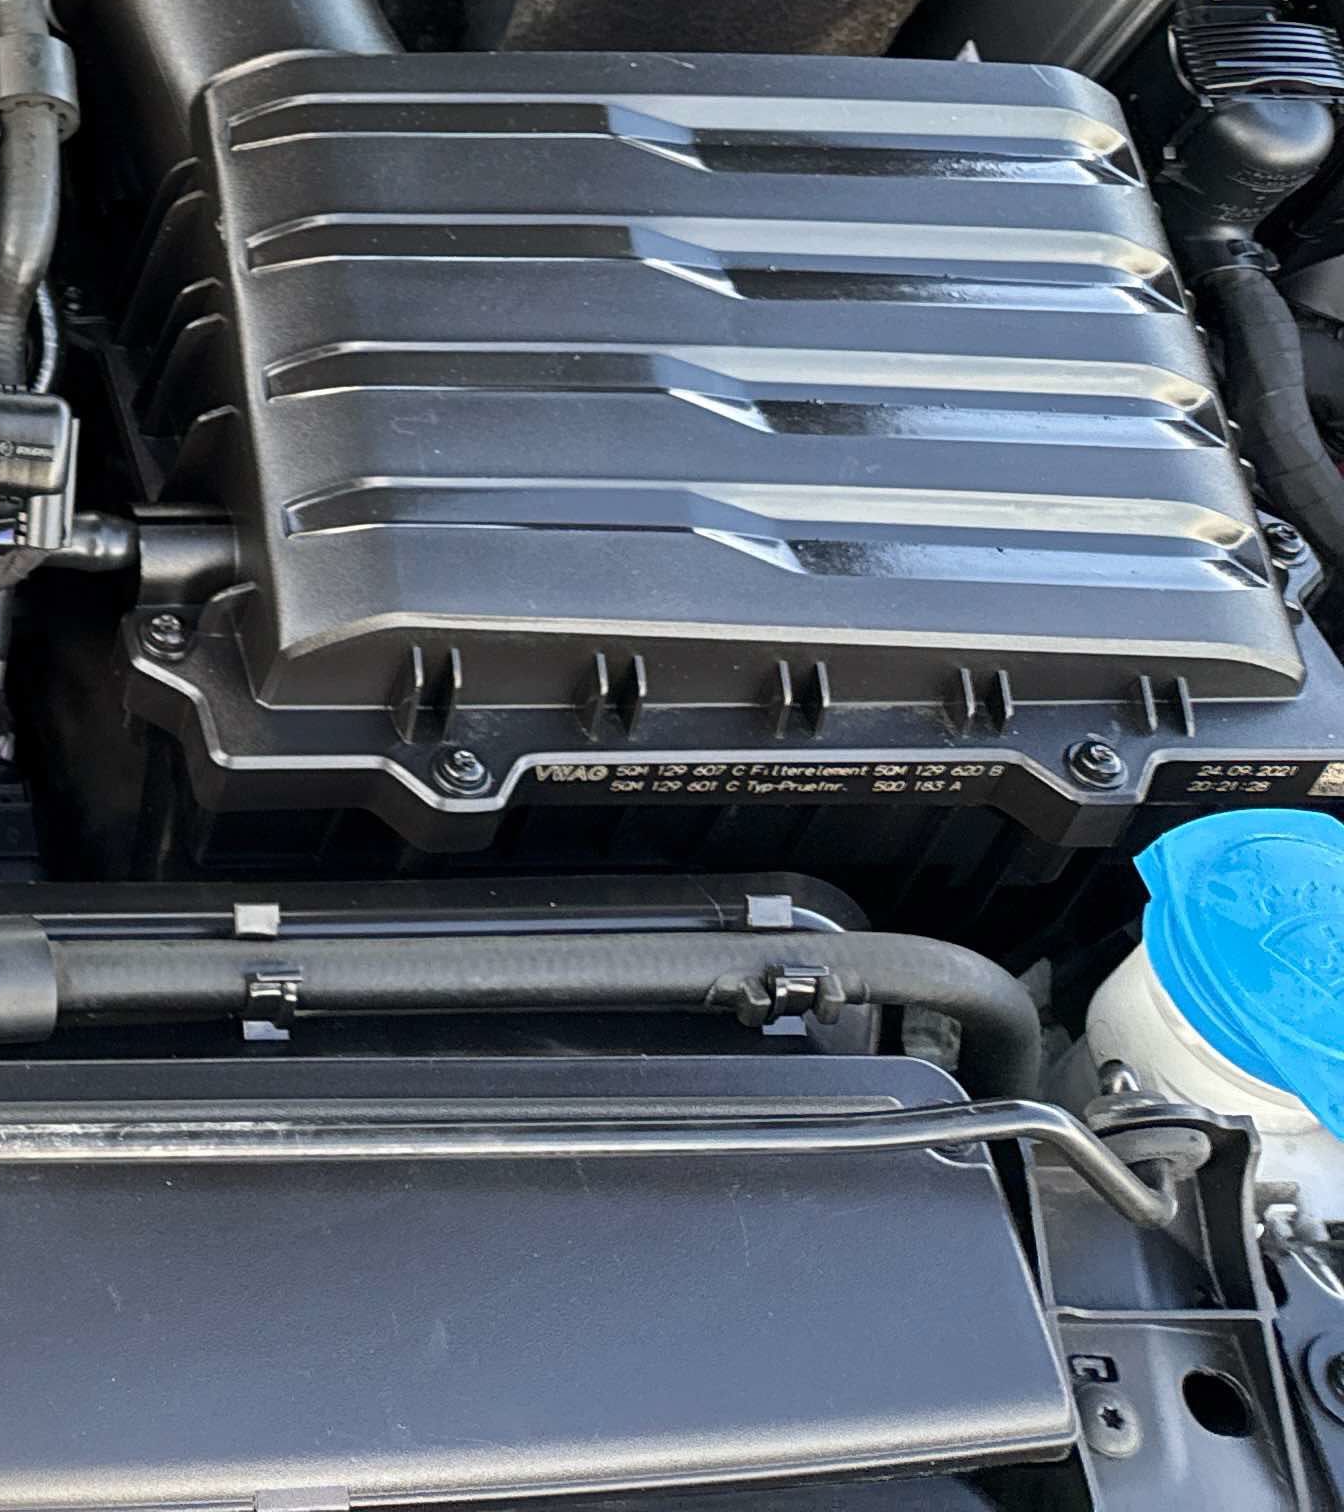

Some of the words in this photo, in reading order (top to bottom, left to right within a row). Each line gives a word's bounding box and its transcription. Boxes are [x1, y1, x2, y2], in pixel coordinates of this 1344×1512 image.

[657, 765, 687, 777] 129
[731, 765, 747, 777] C
[750, 765, 869, 777] Filterelement
[915, 765, 946, 777] 129
[652, 781, 682, 792] 129
[725, 781, 741, 792] C
[949, 780, 963, 792] A
